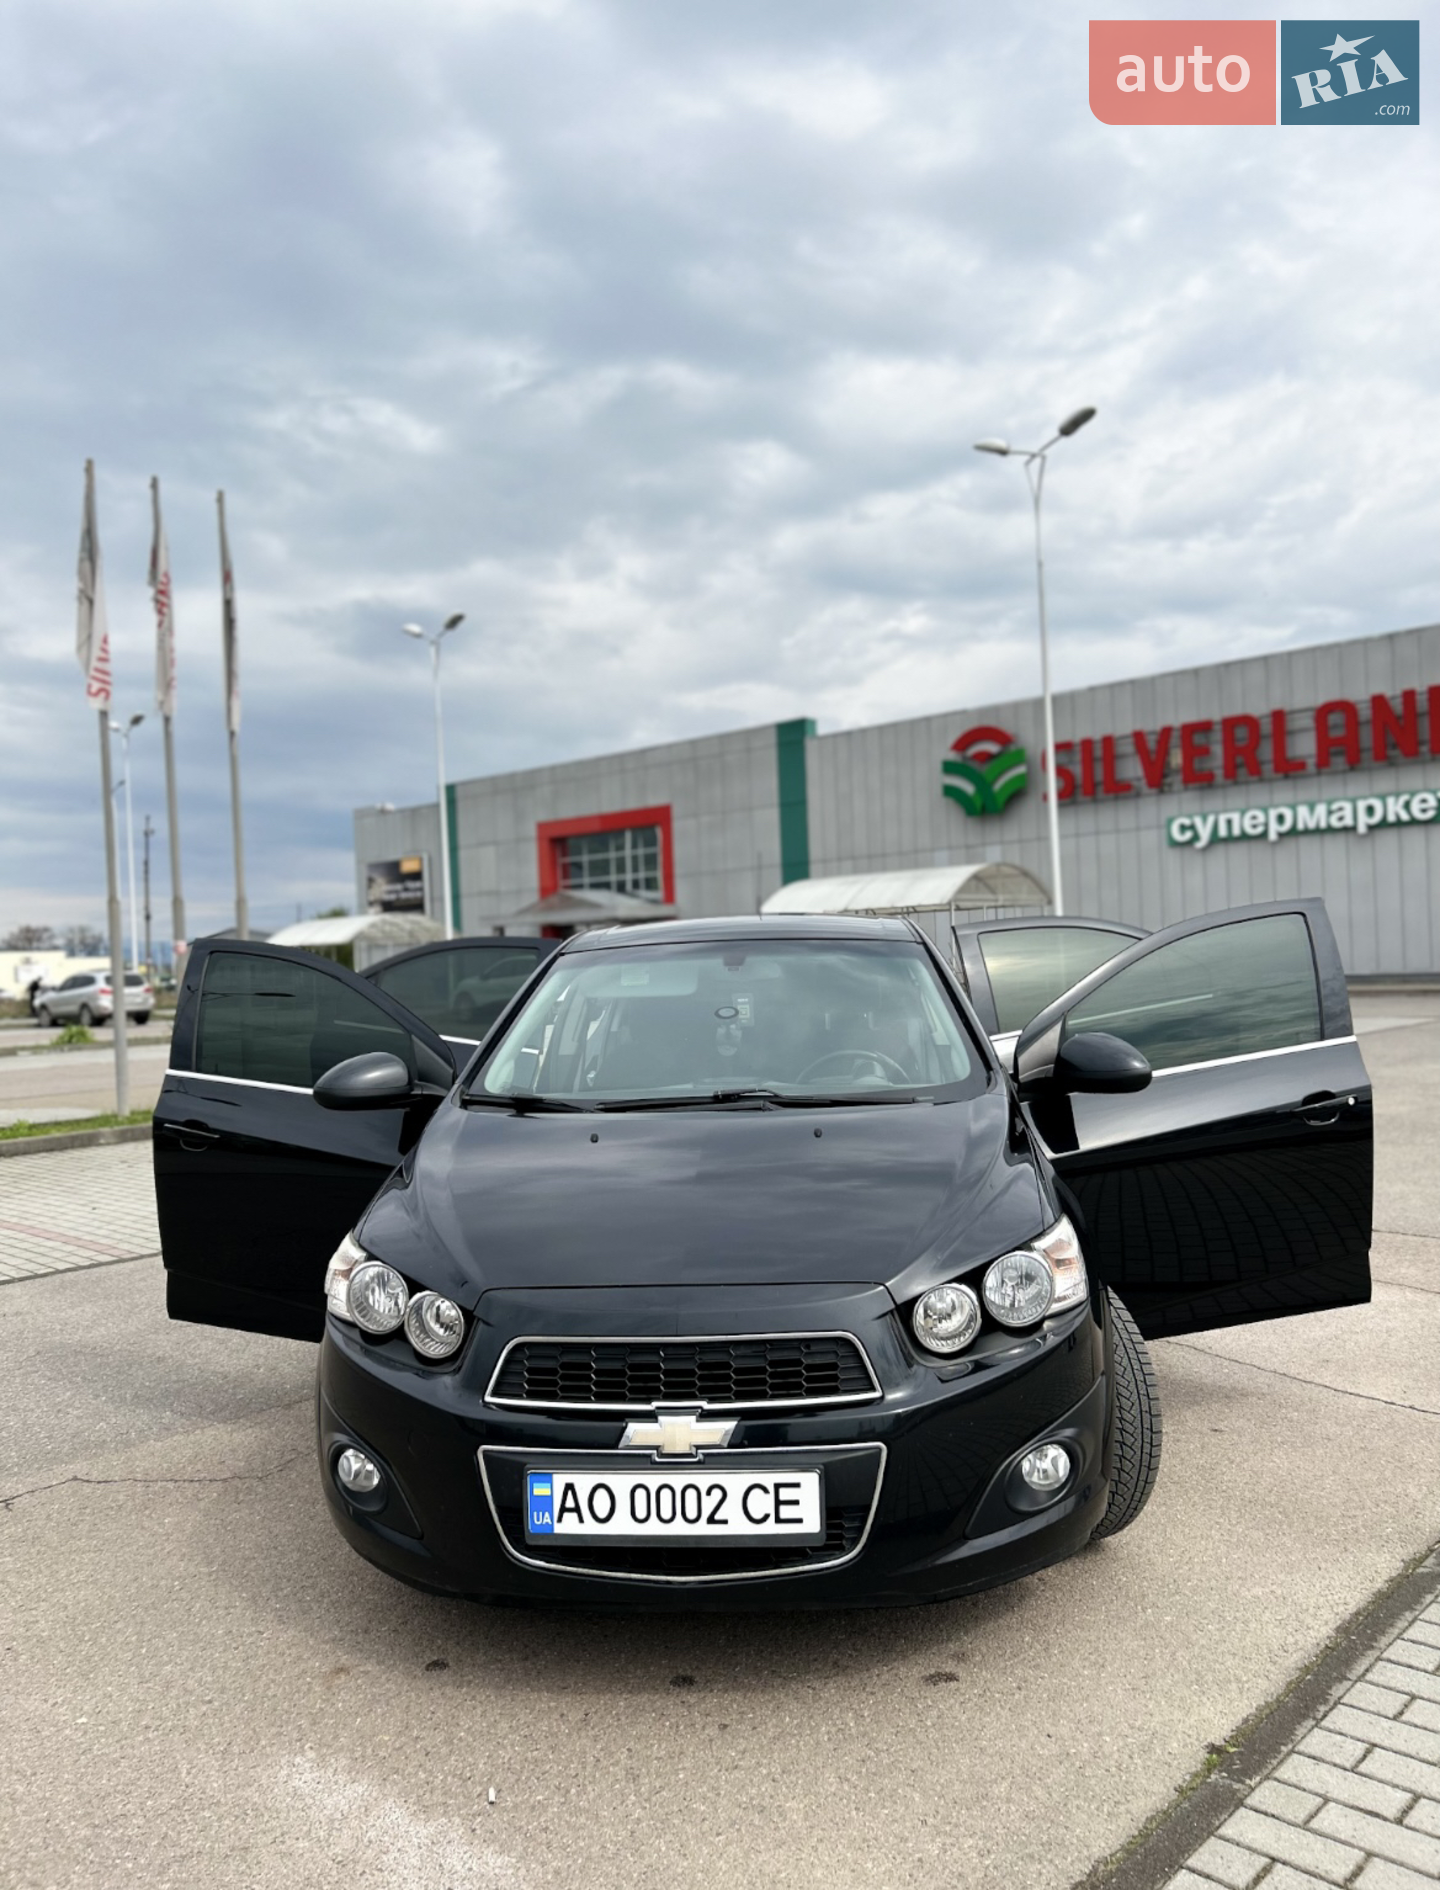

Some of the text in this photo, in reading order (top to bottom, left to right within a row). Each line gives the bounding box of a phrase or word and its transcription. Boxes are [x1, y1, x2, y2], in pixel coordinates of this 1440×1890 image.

[1042, 684, 1440, 803] SILVERLAN
[1170, 790, 1440, 849] супермарке
[533, 1511, 552, 1525] UA
[556, 1482, 804, 1525] AO 0002 CE
